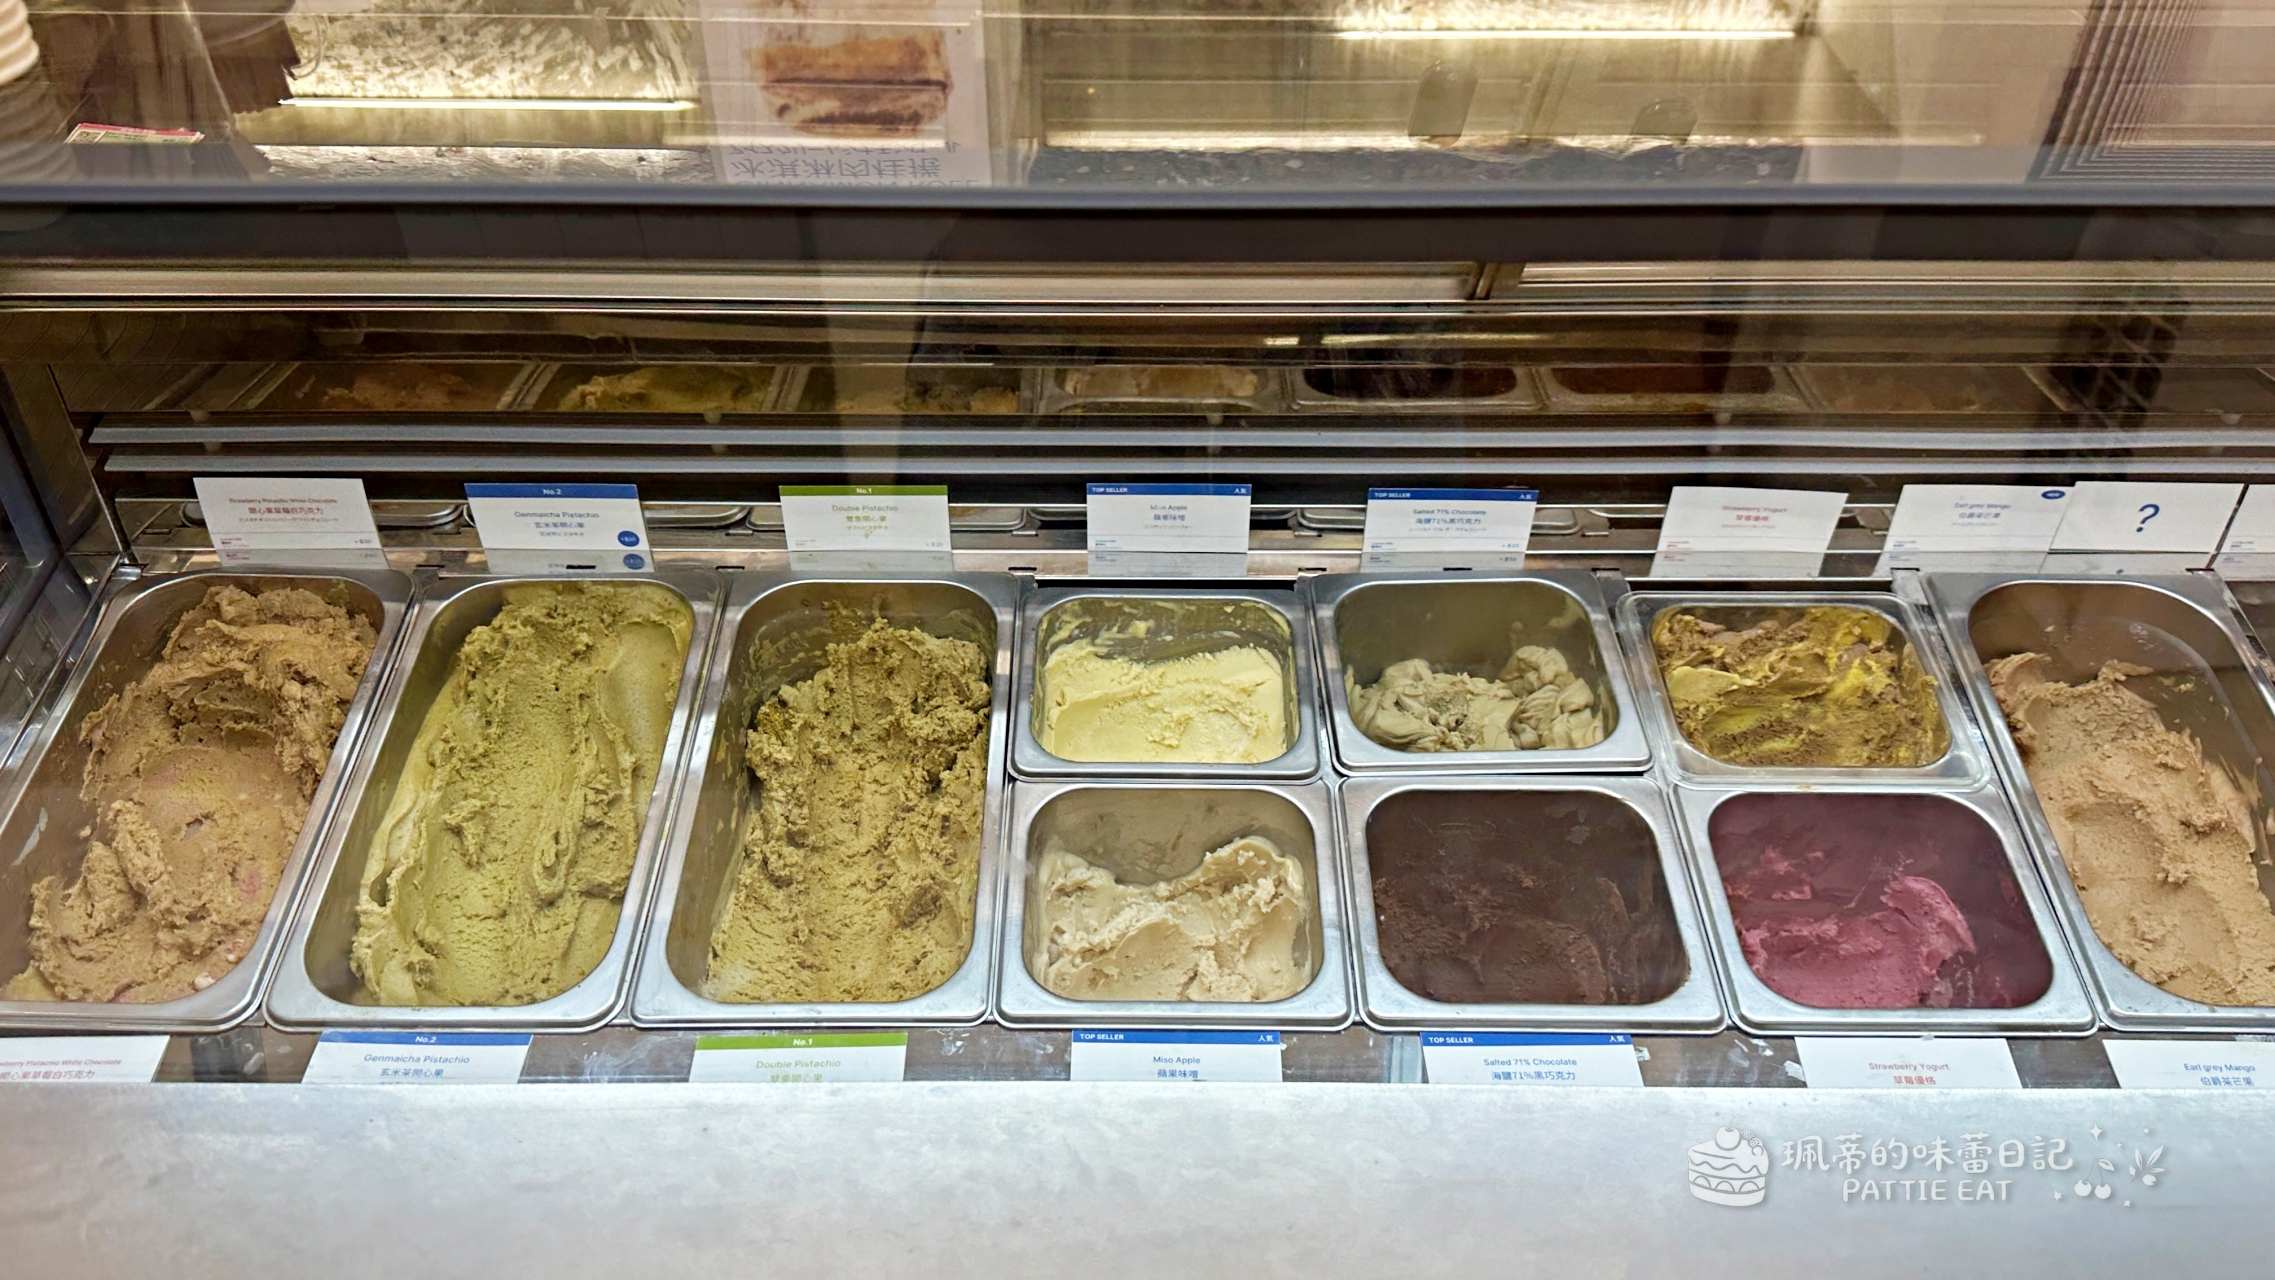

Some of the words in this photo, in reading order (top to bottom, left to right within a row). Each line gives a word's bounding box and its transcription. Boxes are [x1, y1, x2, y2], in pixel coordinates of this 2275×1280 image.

[562, 511, 600, 519] Pistachio
[2136, 504, 2160, 532] ?
[415, 1036, 437, 1044] No.2
[793, 1038, 813, 1046] No.1
[364, 1054, 421, 1063] Genmaicha
[423, 1055, 470, 1064] Pistachio
[756, 1060, 792, 1069] Double
[794, 1059, 841, 1068] Pistachio
[1153, 1056, 1174, 1064] Miso
[1175, 1056, 1201, 1065] Apple
[1484, 1058, 1512, 1066] Salted
[1513, 1058, 1531, 1066] 71%
[1532, 1058, 1577, 1066] Chocolate
[1869, 1062, 1918, 1071] Strawberry
[1919, 1063, 1950, 1072] Yogurt
[2184, 1063, 2201, 1071] Earl
[2203, 1064, 2223, 1073] grey
[2224, 1064, 2256, 1073] Mango
[380, 1068, 444, 1078] 玄米茶開心果
[1157, 1069, 1199, 1079] 蘋果味噌
[1893, 1076, 1936, 1085] 草莓優格
[2200, 1076, 2255, 1086] 伯爵茶芒果
